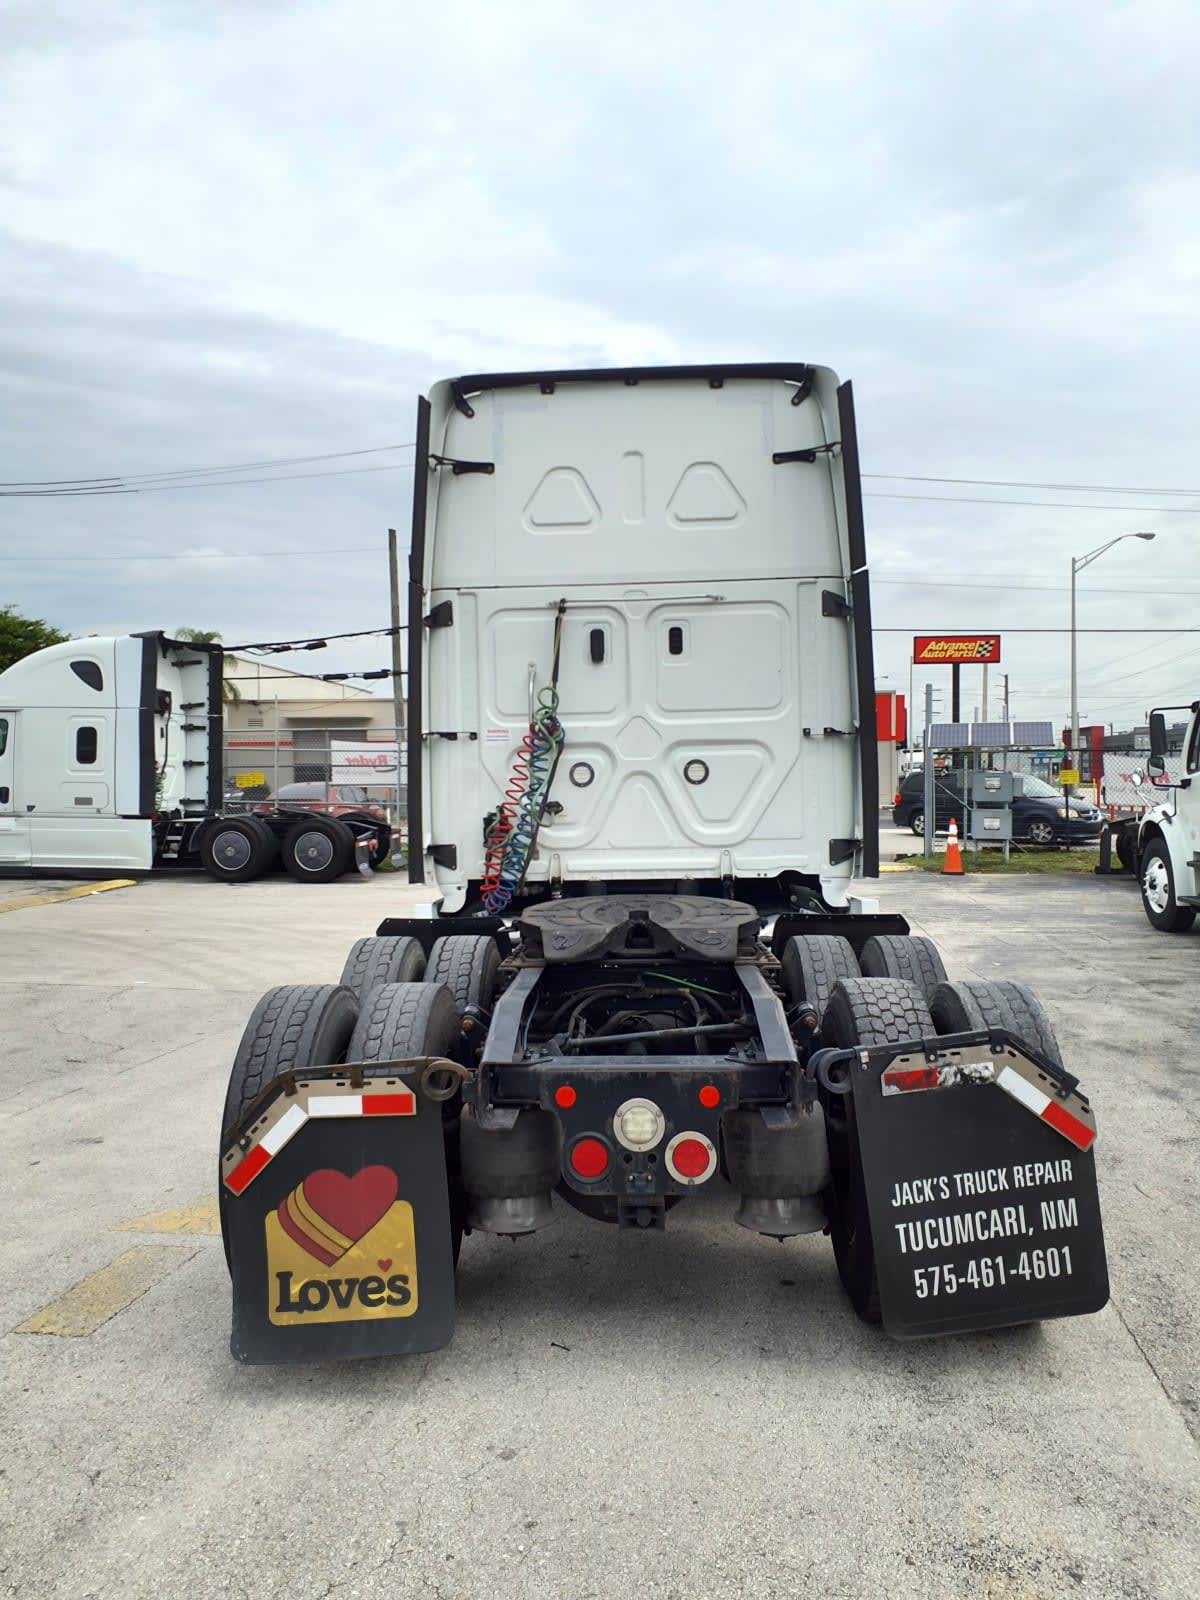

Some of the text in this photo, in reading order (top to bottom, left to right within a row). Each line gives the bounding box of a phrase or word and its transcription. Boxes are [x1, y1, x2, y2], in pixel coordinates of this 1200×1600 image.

[920, 649, 972, 658] Auto Parts
[927, 641, 975, 650] Advance
[891, 1159, 1073, 1207] JACK'S TRUCK REPAIR
[895, 1197, 1079, 1253] TUCUMCARI, NM
[913, 1245, 1073, 1298] 575-461-4601
